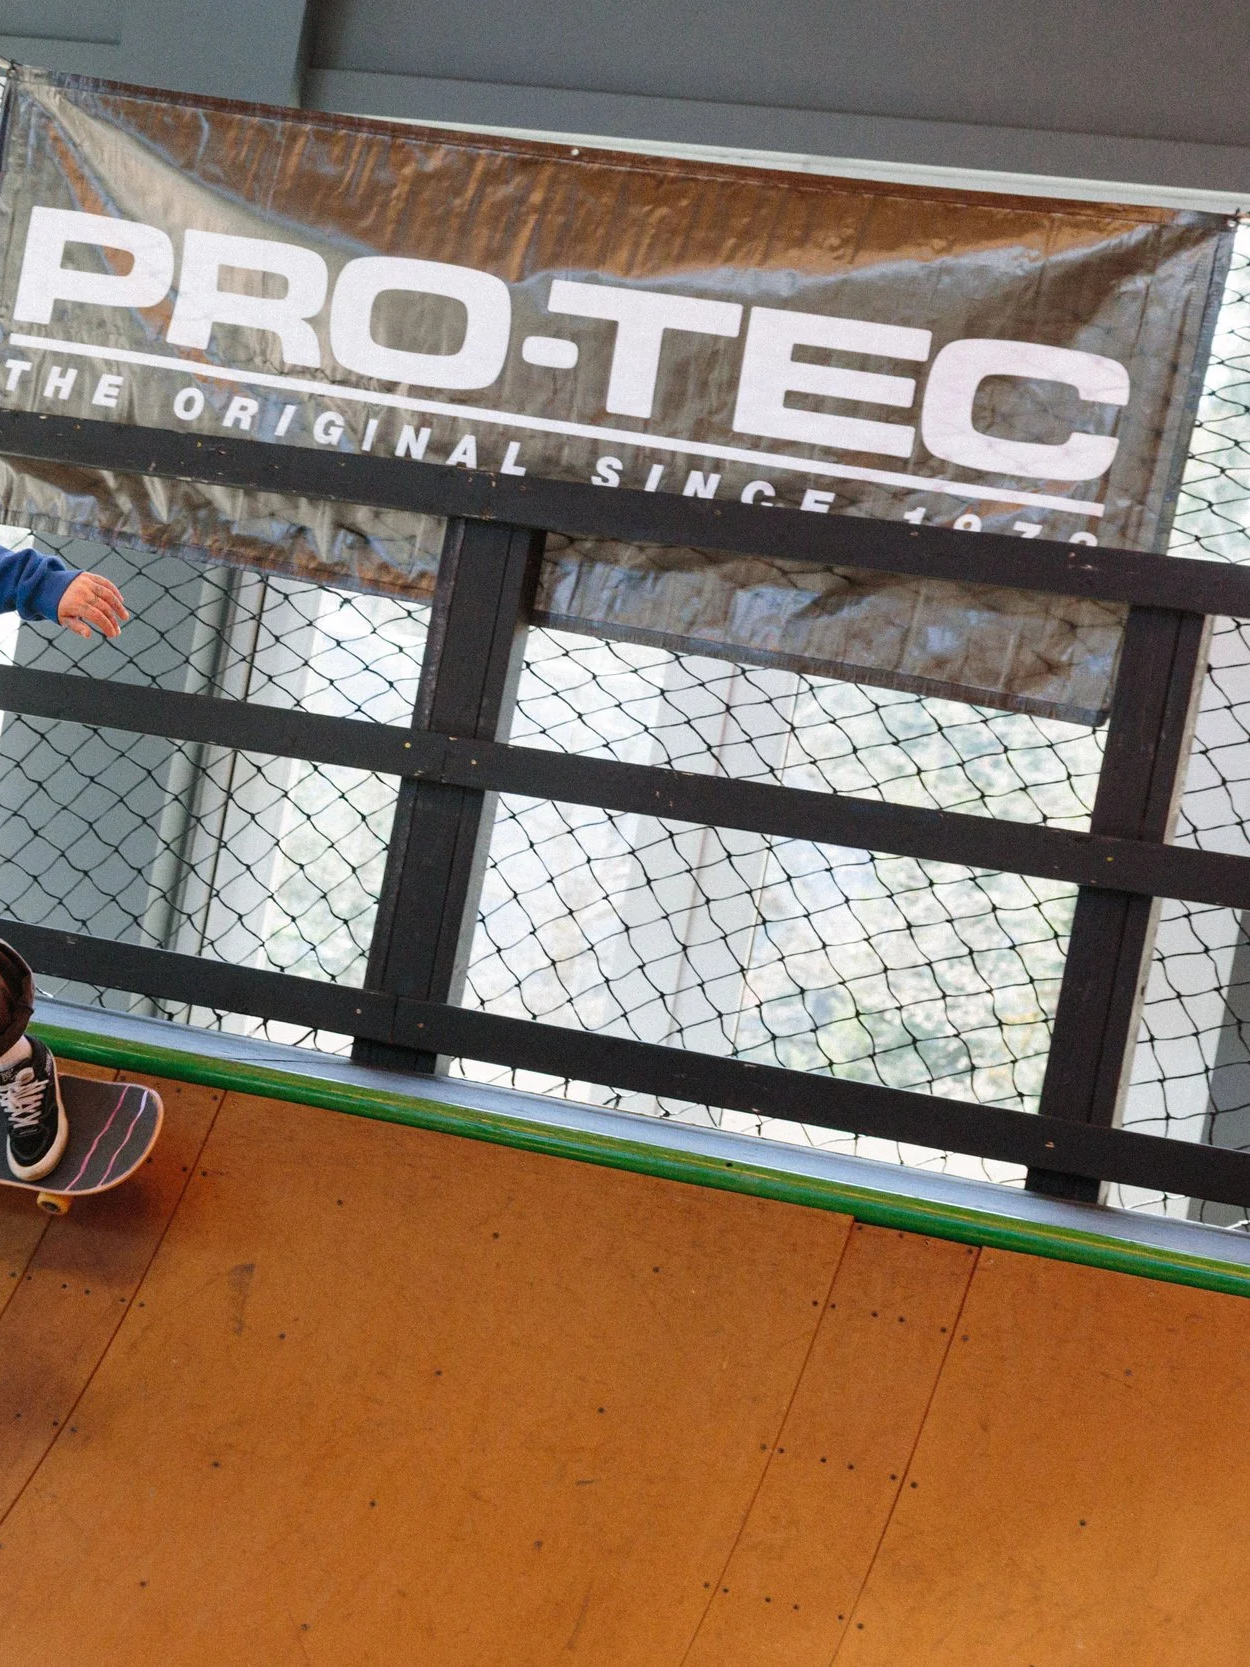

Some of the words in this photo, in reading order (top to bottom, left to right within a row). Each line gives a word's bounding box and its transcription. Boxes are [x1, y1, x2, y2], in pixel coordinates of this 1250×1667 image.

[4, 358, 125, 408] THE
[172, 386, 527, 477] ORIGINAL
[590, 455, 836, 514] SINCE
[13, 205, 1130, 481] PRO-TEC
